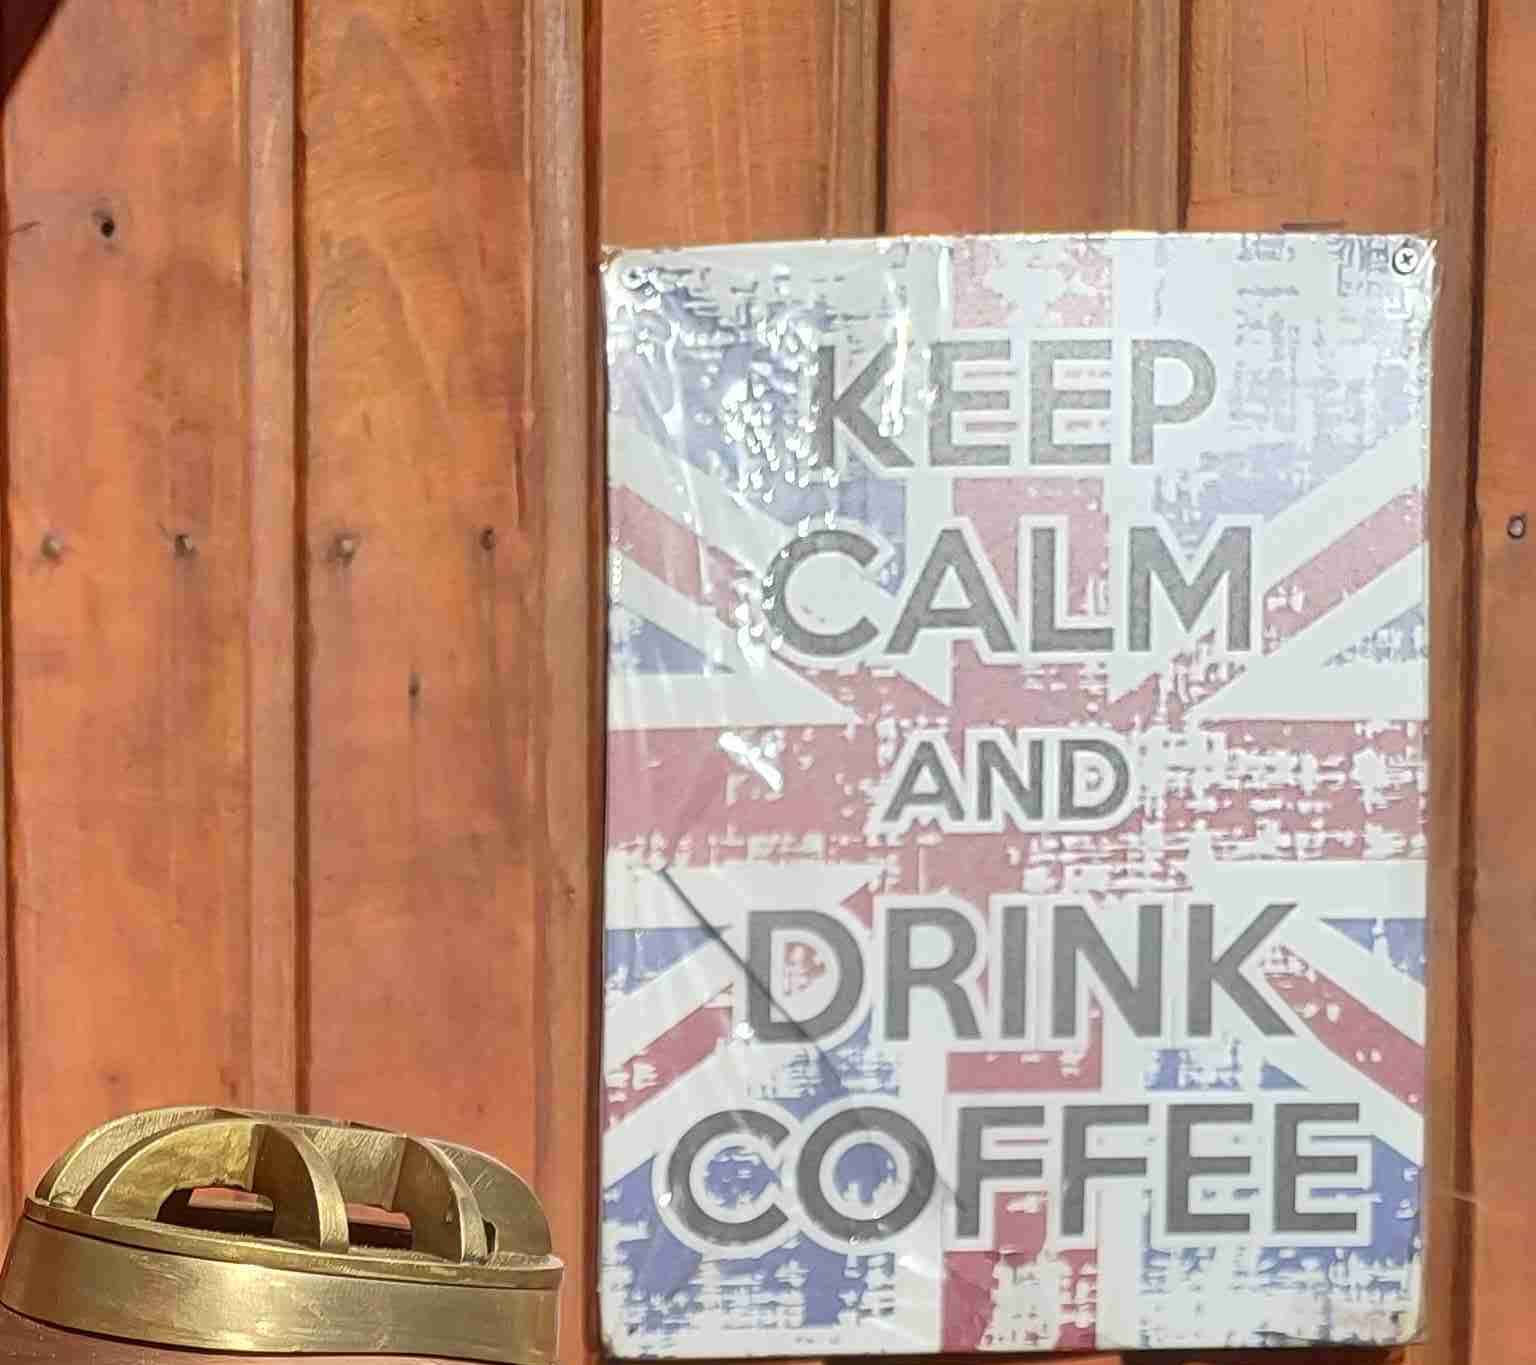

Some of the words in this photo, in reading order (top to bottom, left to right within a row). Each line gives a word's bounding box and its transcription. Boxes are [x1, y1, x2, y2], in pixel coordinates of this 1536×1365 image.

[810, 338, 1216, 470] KEEP
[766, 524, 1252, 658] CALM
[880, 737, 1131, 822] AND
[744, 902, 1297, 1043] DRINK
[665, 1101, 1361, 1246] COFFEE
